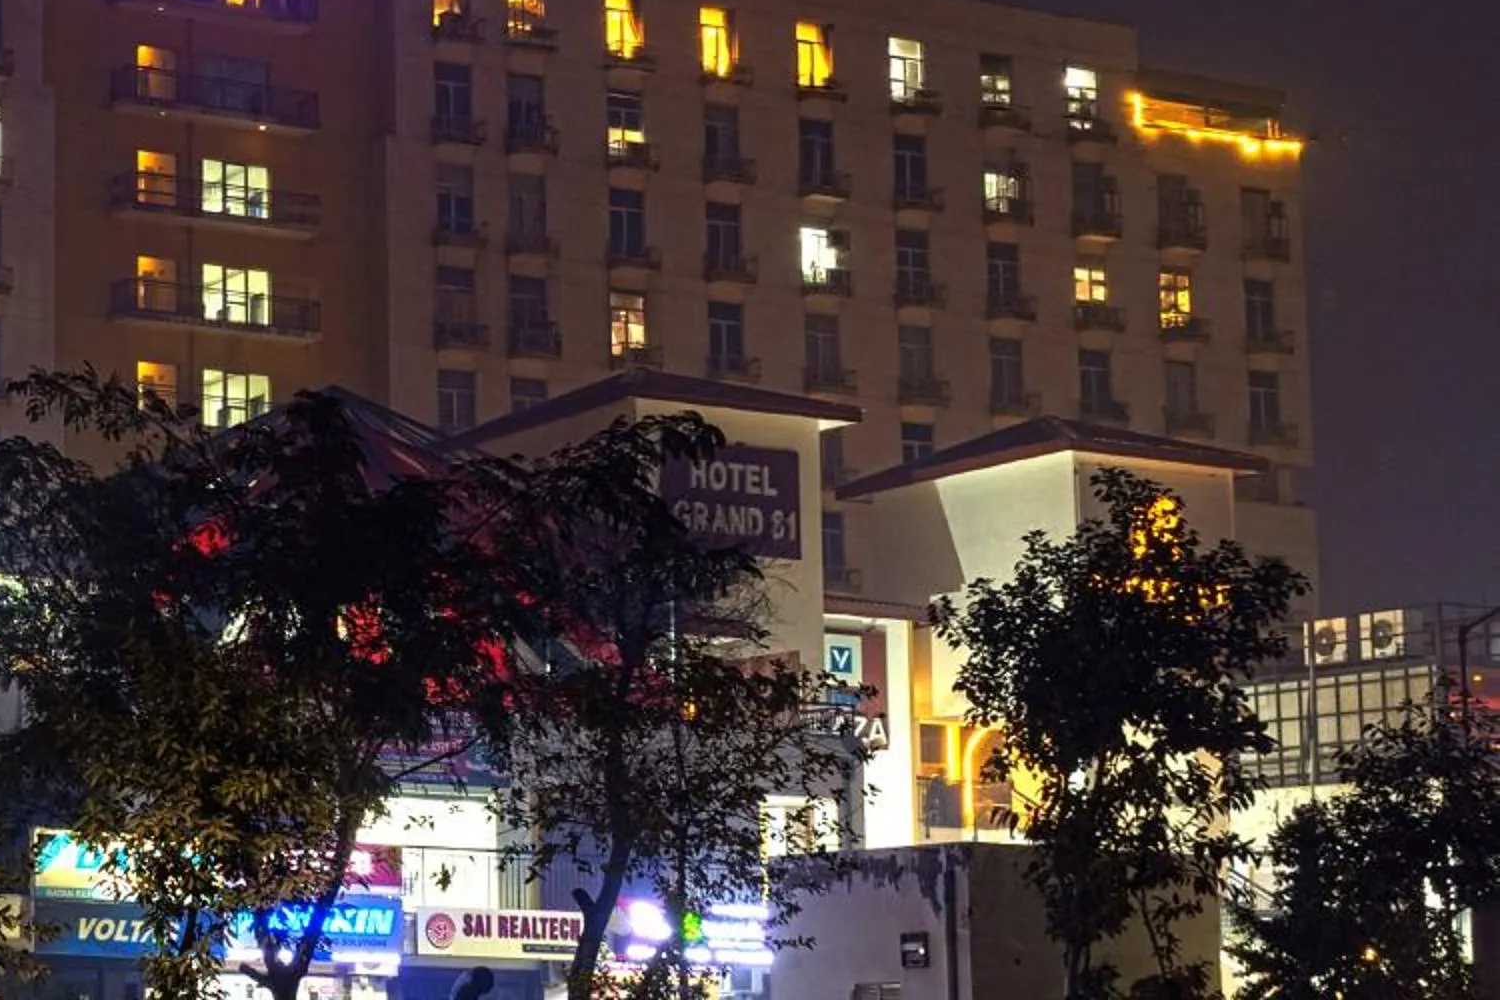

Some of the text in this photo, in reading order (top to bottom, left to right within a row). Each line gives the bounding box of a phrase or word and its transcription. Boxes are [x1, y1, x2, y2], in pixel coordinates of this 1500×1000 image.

[690, 459, 778, 497] HOTEL
[673, 500, 763, 536] GRAND
[463, 913, 492, 938] SAI
